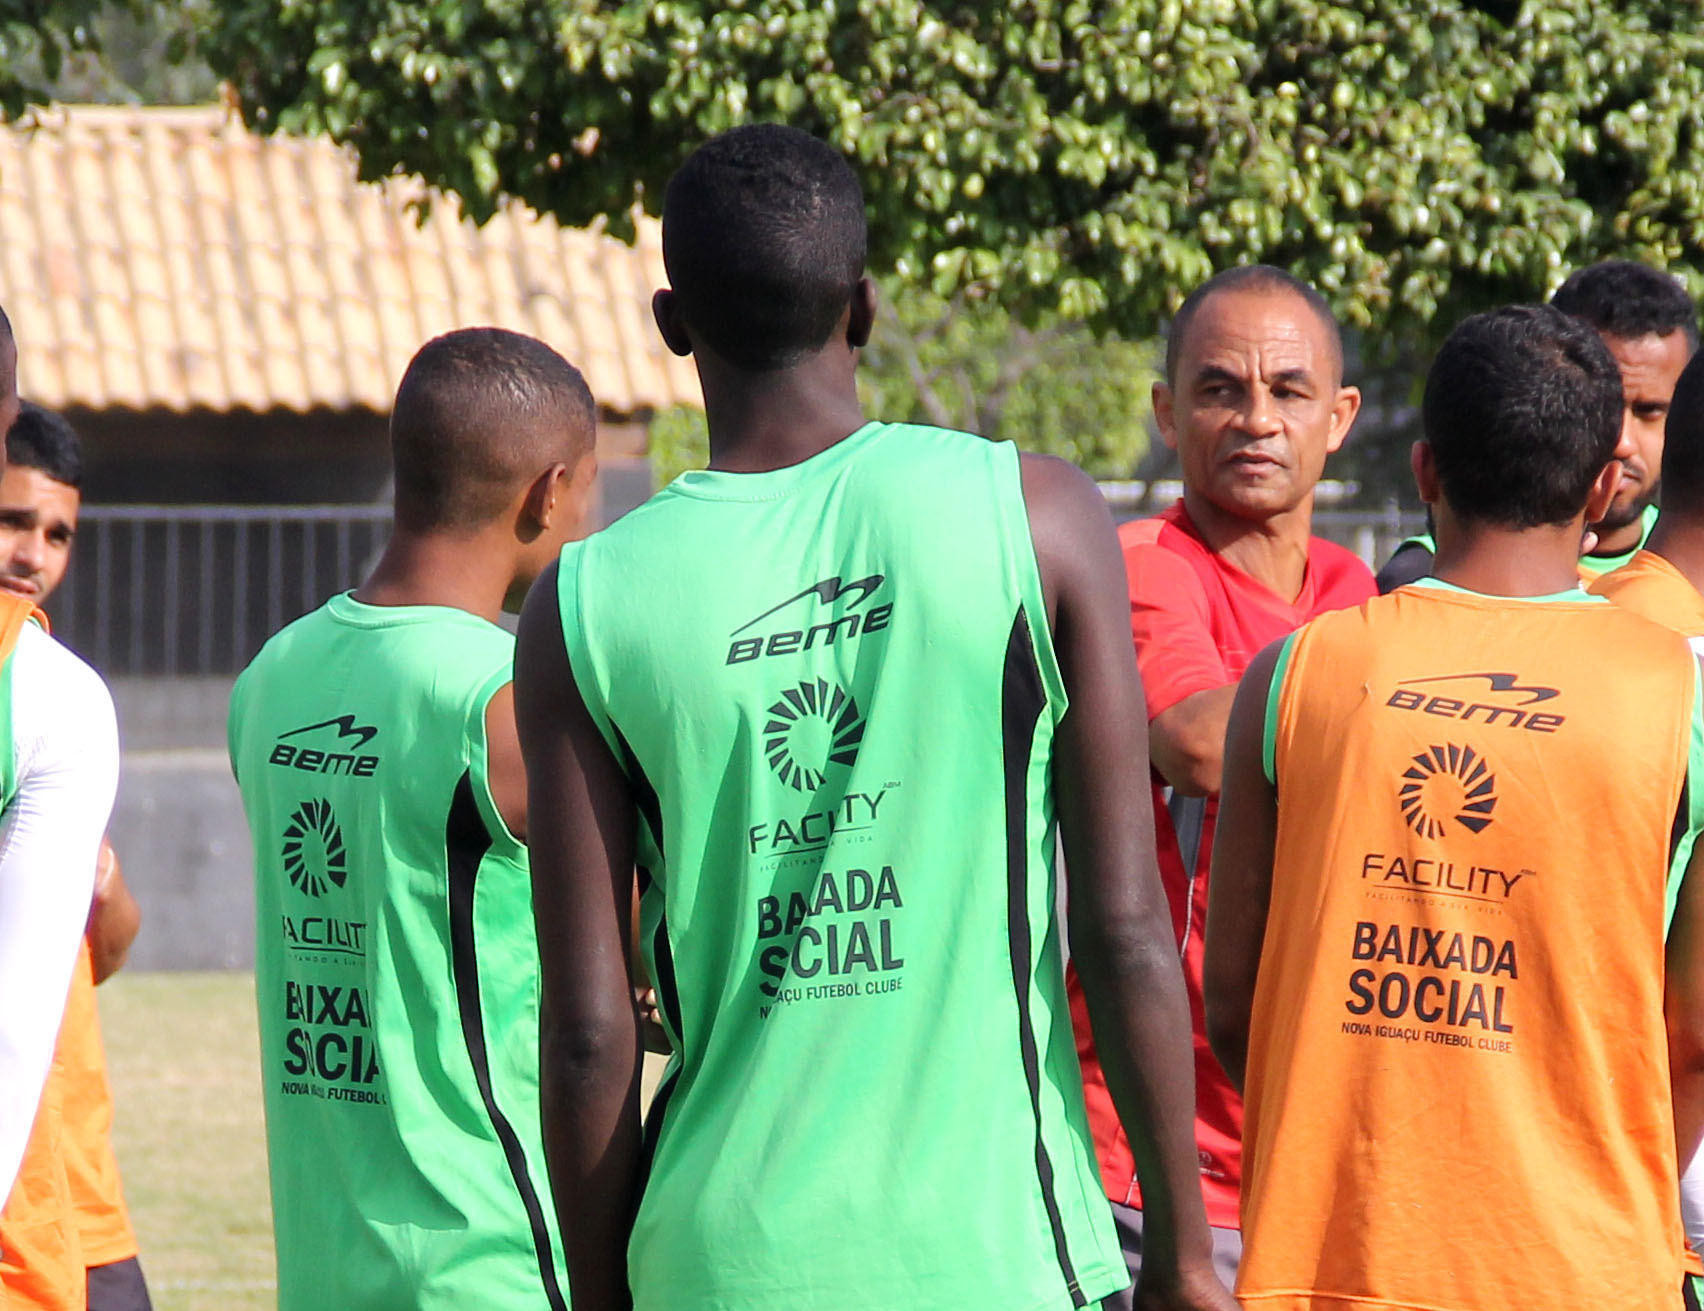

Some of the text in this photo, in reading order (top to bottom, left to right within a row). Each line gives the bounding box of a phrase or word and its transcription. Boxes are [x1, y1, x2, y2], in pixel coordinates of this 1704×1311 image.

[748, 790, 887, 854] FACITY
[758, 865, 904, 940] BAADA
[1362, 853, 1523, 898] FACILITY
[758, 918, 905, 998] SCIAL
[1352, 920, 1519, 980] BAIXADA
[807, 982, 862, 1001] FUTEBOL
[865, 977, 904, 996] CLUBE
[1345, 967, 1515, 1034] SOCIAL
[1342, 1021, 1514, 1054] NOVA IGUAÇU FUTEBOL CLUBE
